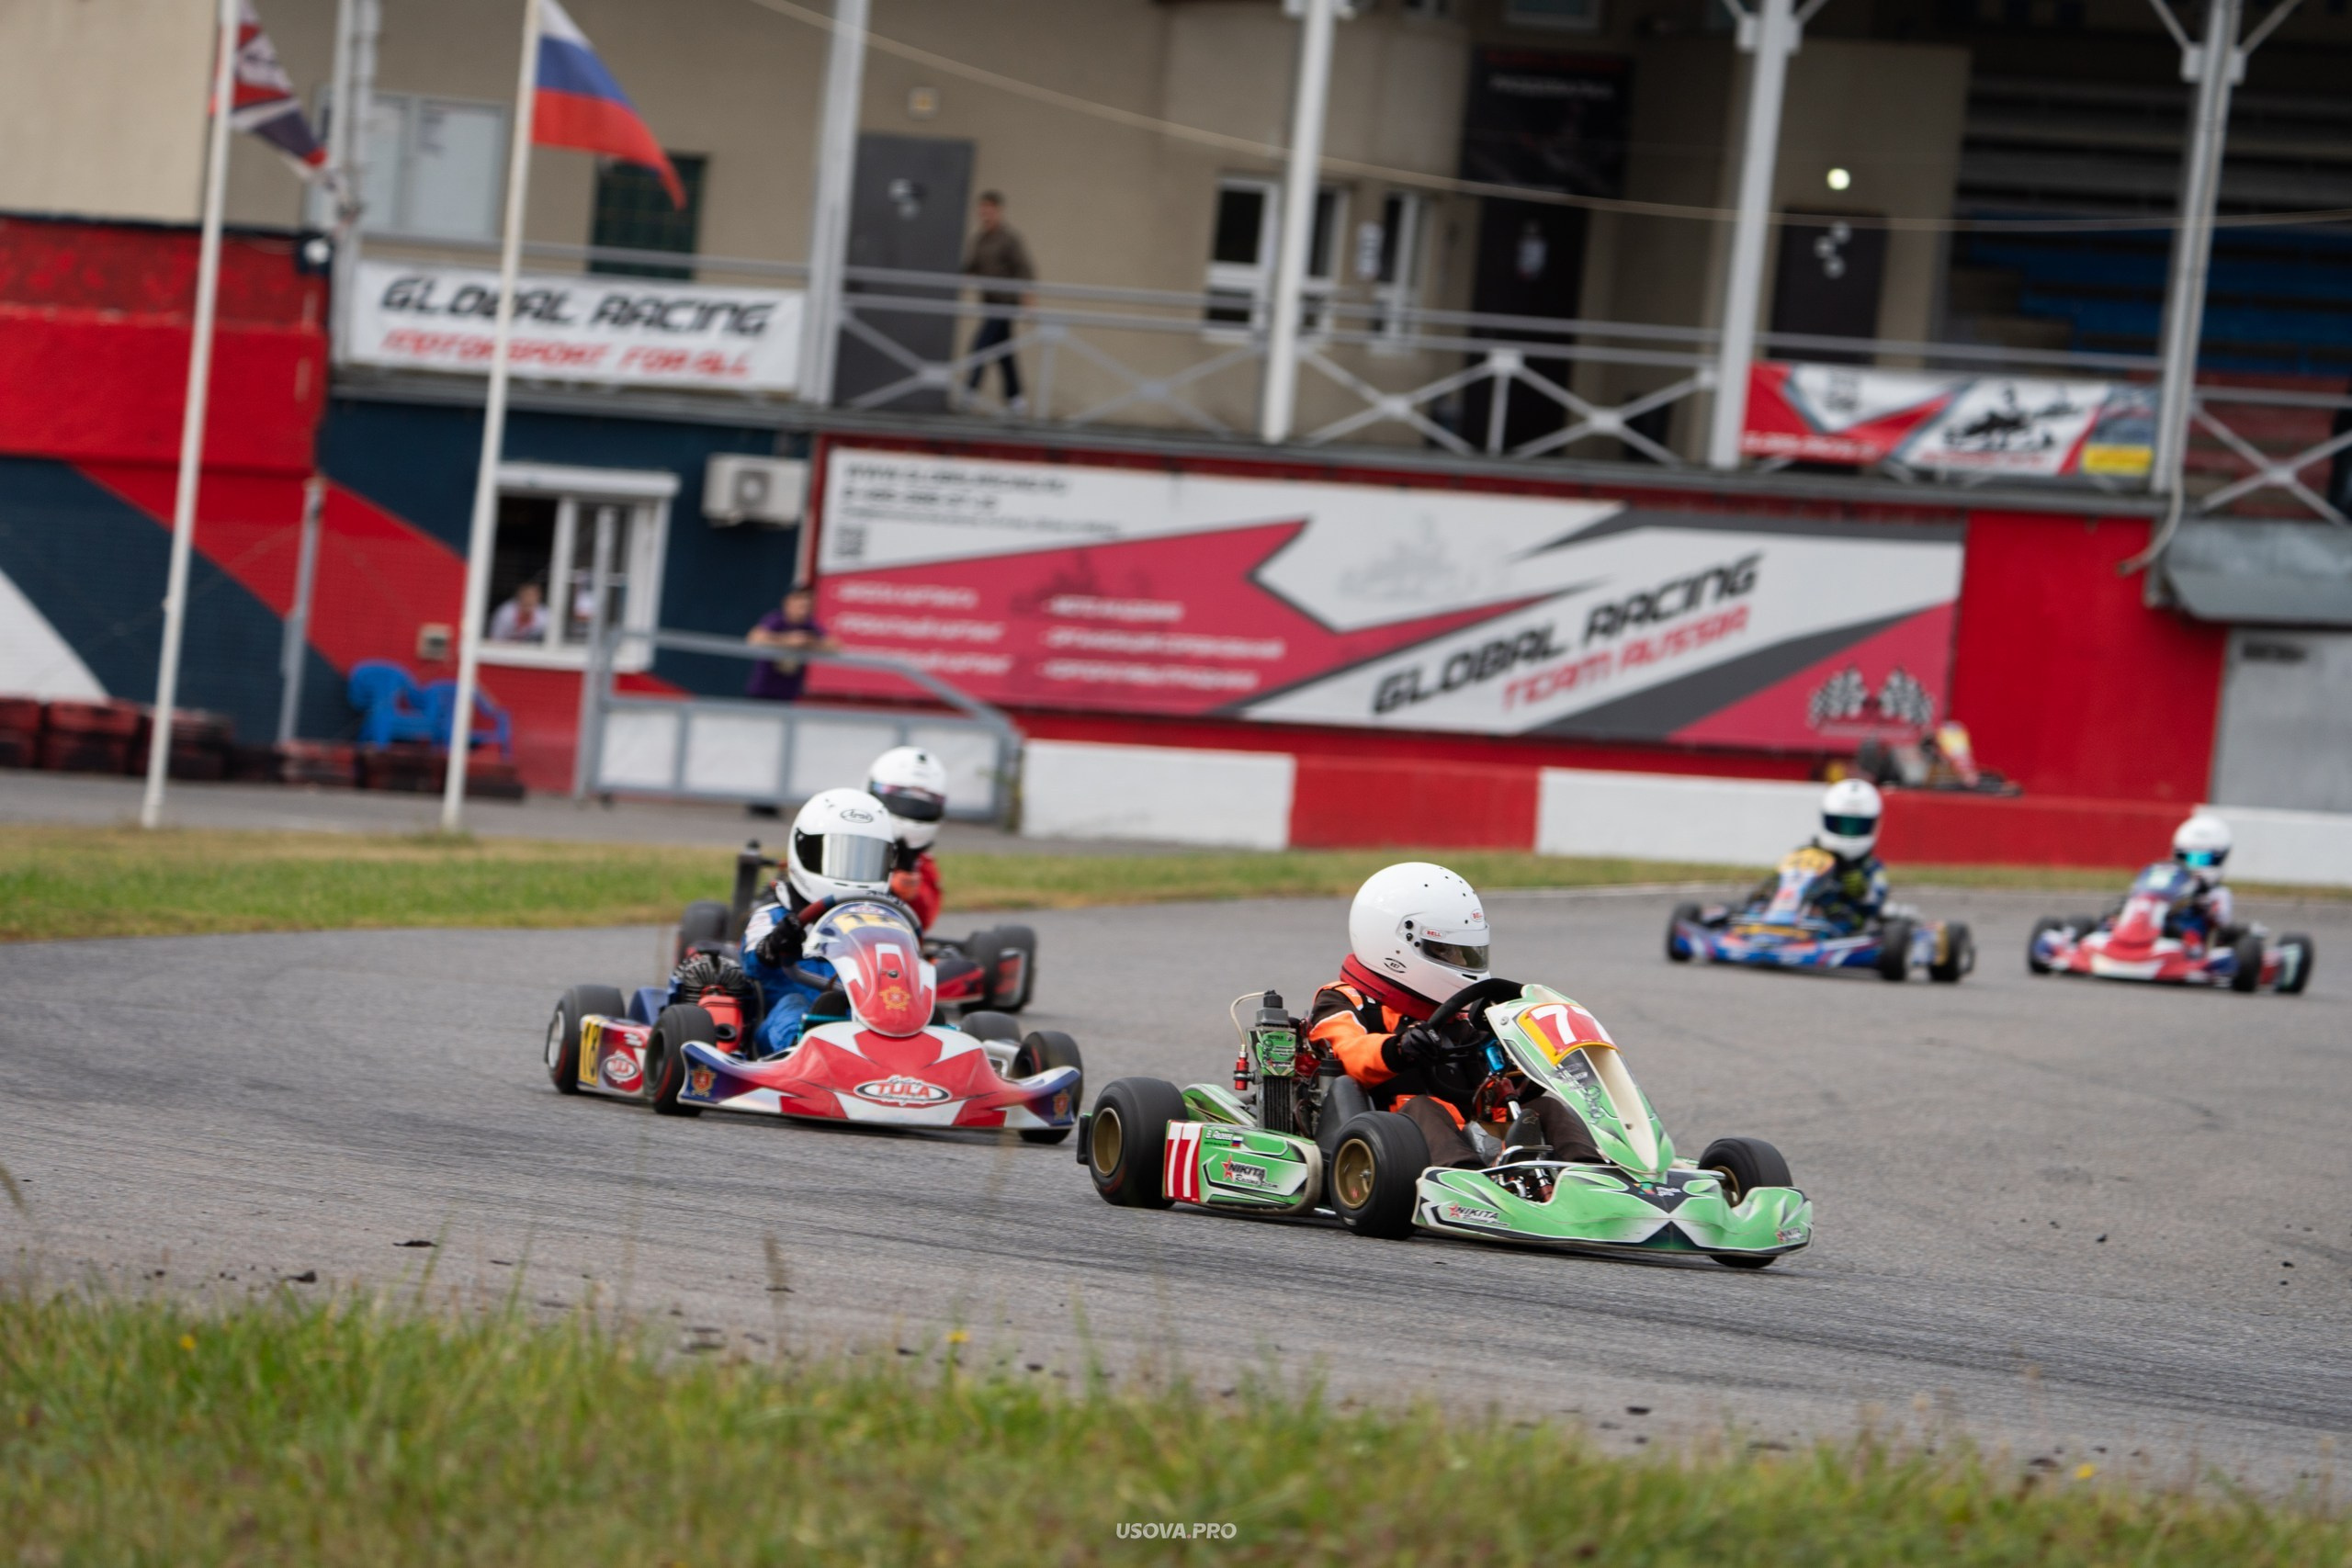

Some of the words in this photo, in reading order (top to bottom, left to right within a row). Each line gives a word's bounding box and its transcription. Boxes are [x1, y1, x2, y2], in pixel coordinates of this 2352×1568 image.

[382, 276, 575, 326] GLOBAL
[591, 294, 778, 336] RACING
[617, 345, 691, 373] FOR
[696, 352, 752, 378] ALL
[1370, 625, 1571, 715] GLOBAL
[1583, 551, 1764, 645] RACING
[1502, 650, 1612, 712] TEAM
[1619, 604, 1751, 671] RUSSIA
[1426, 930, 1442, 938] BELL
[1530, 1004, 1614, 1045] 77
[877, 1084, 930, 1098] TULA
[1168, 1122, 1202, 1197] 77
[1228, 1163, 1265, 1179] NIKITA
[1457, 1207, 1498, 1219] NIKITA
